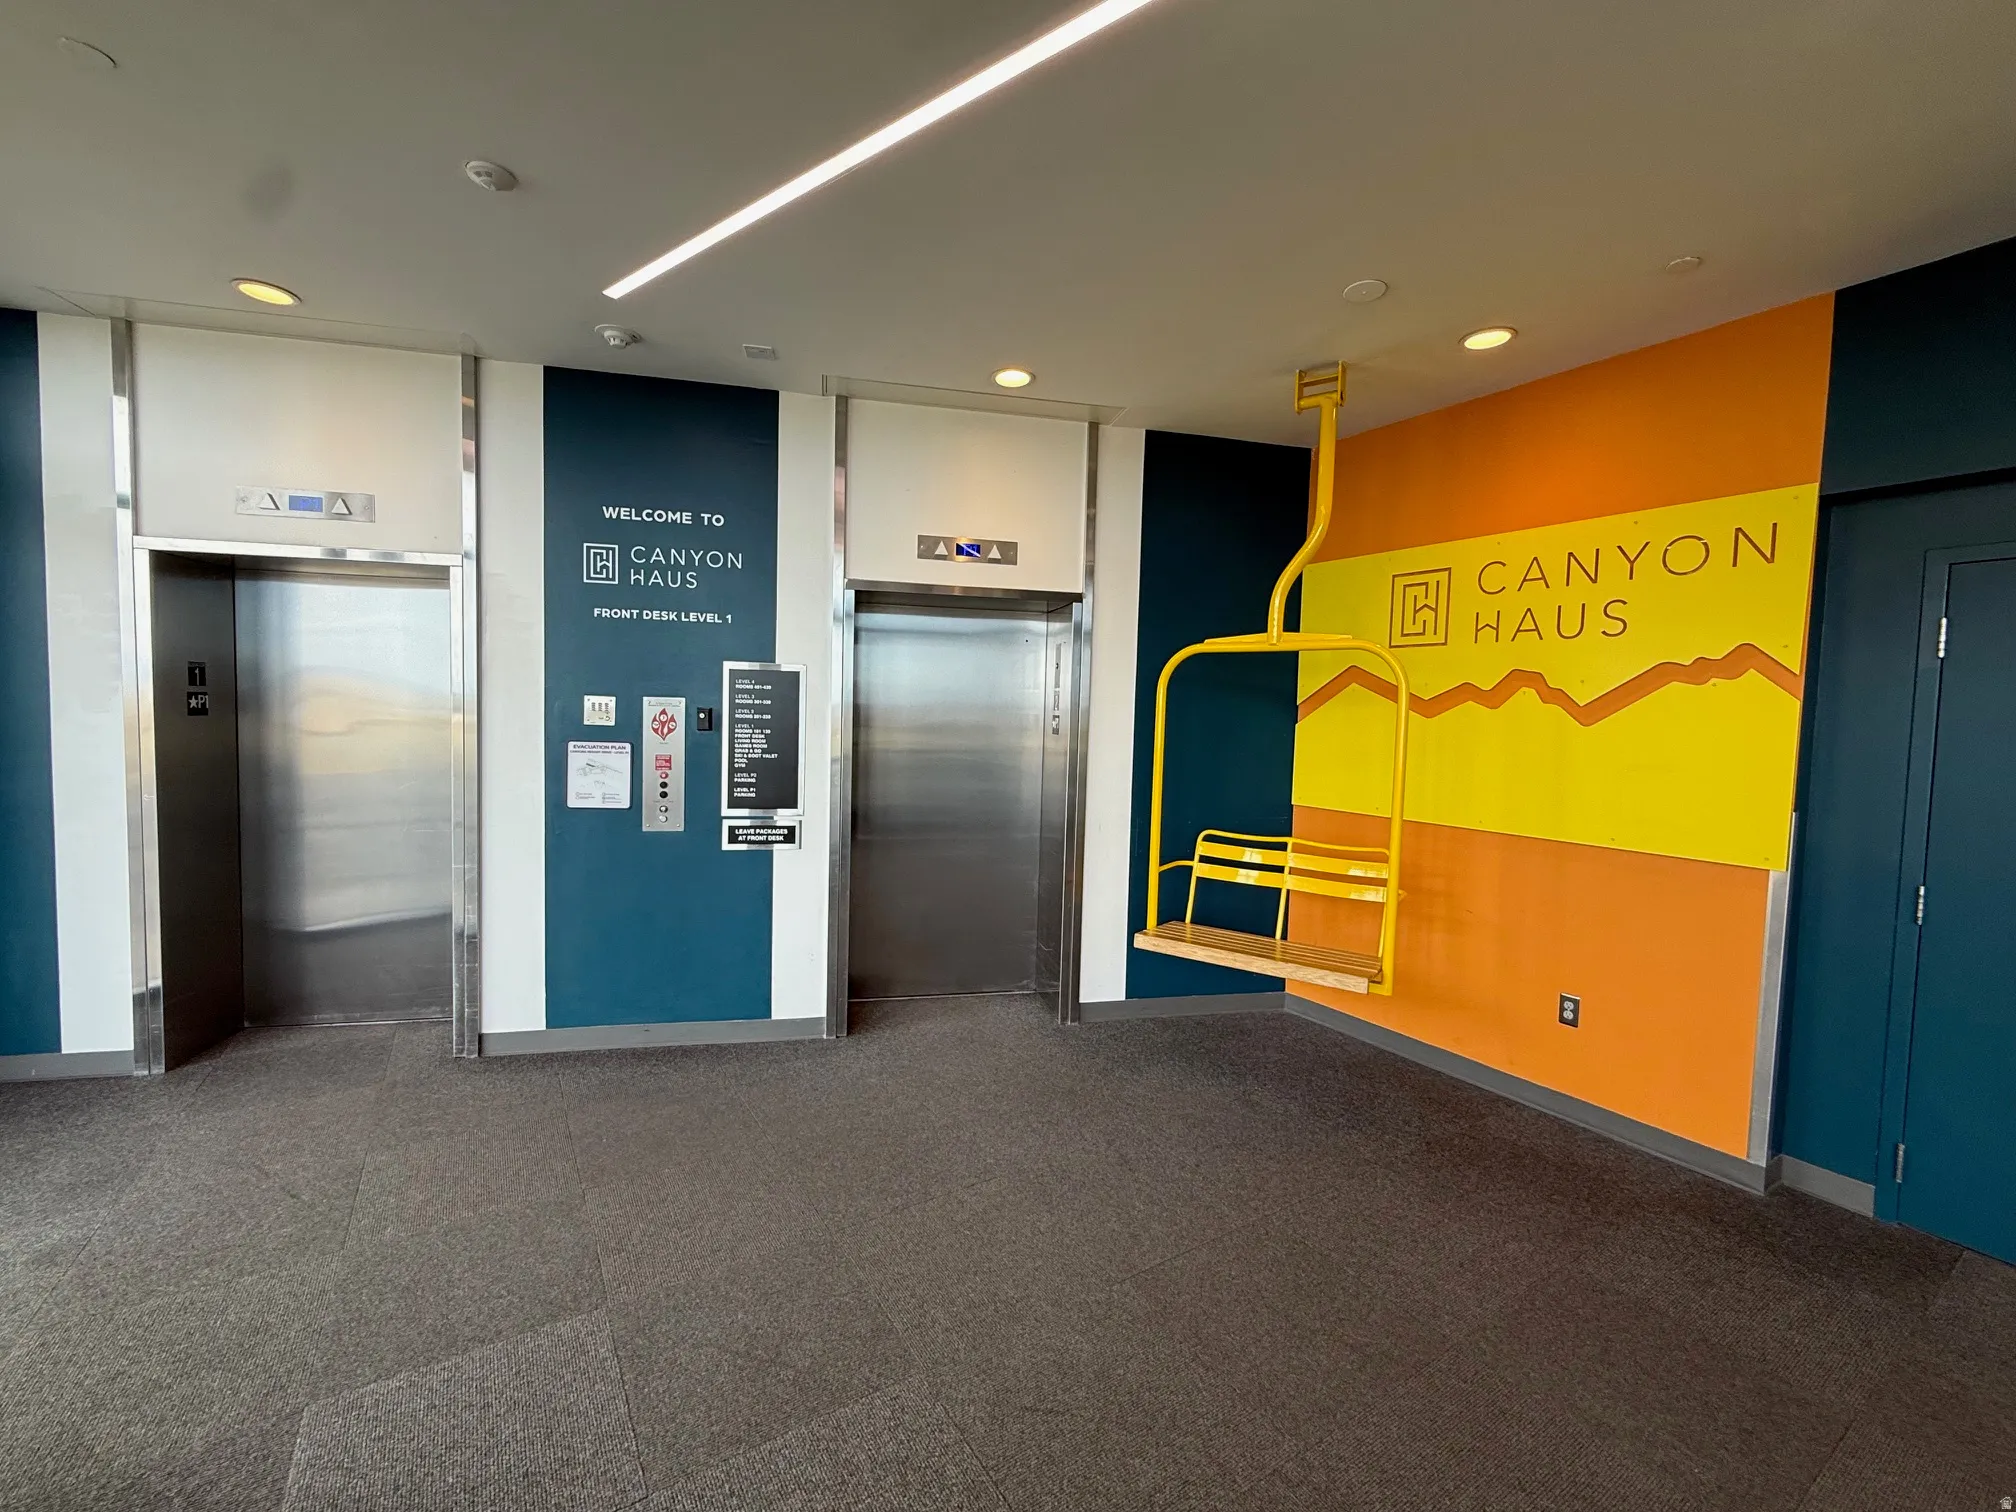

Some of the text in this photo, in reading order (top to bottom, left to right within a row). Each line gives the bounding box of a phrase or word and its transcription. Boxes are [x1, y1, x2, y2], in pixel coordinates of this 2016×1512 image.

[602, 506, 725, 527] WELCOME TO
[630, 545, 743, 569] CANYON
[1477, 522, 1778, 595] CANYON
[630, 568, 698, 589] HAUS
[593, 608, 732, 624] FRONT DESK LEVEL 1
[1473, 598, 1629, 644] HAUS
[194, 667, 200, 686] 1
